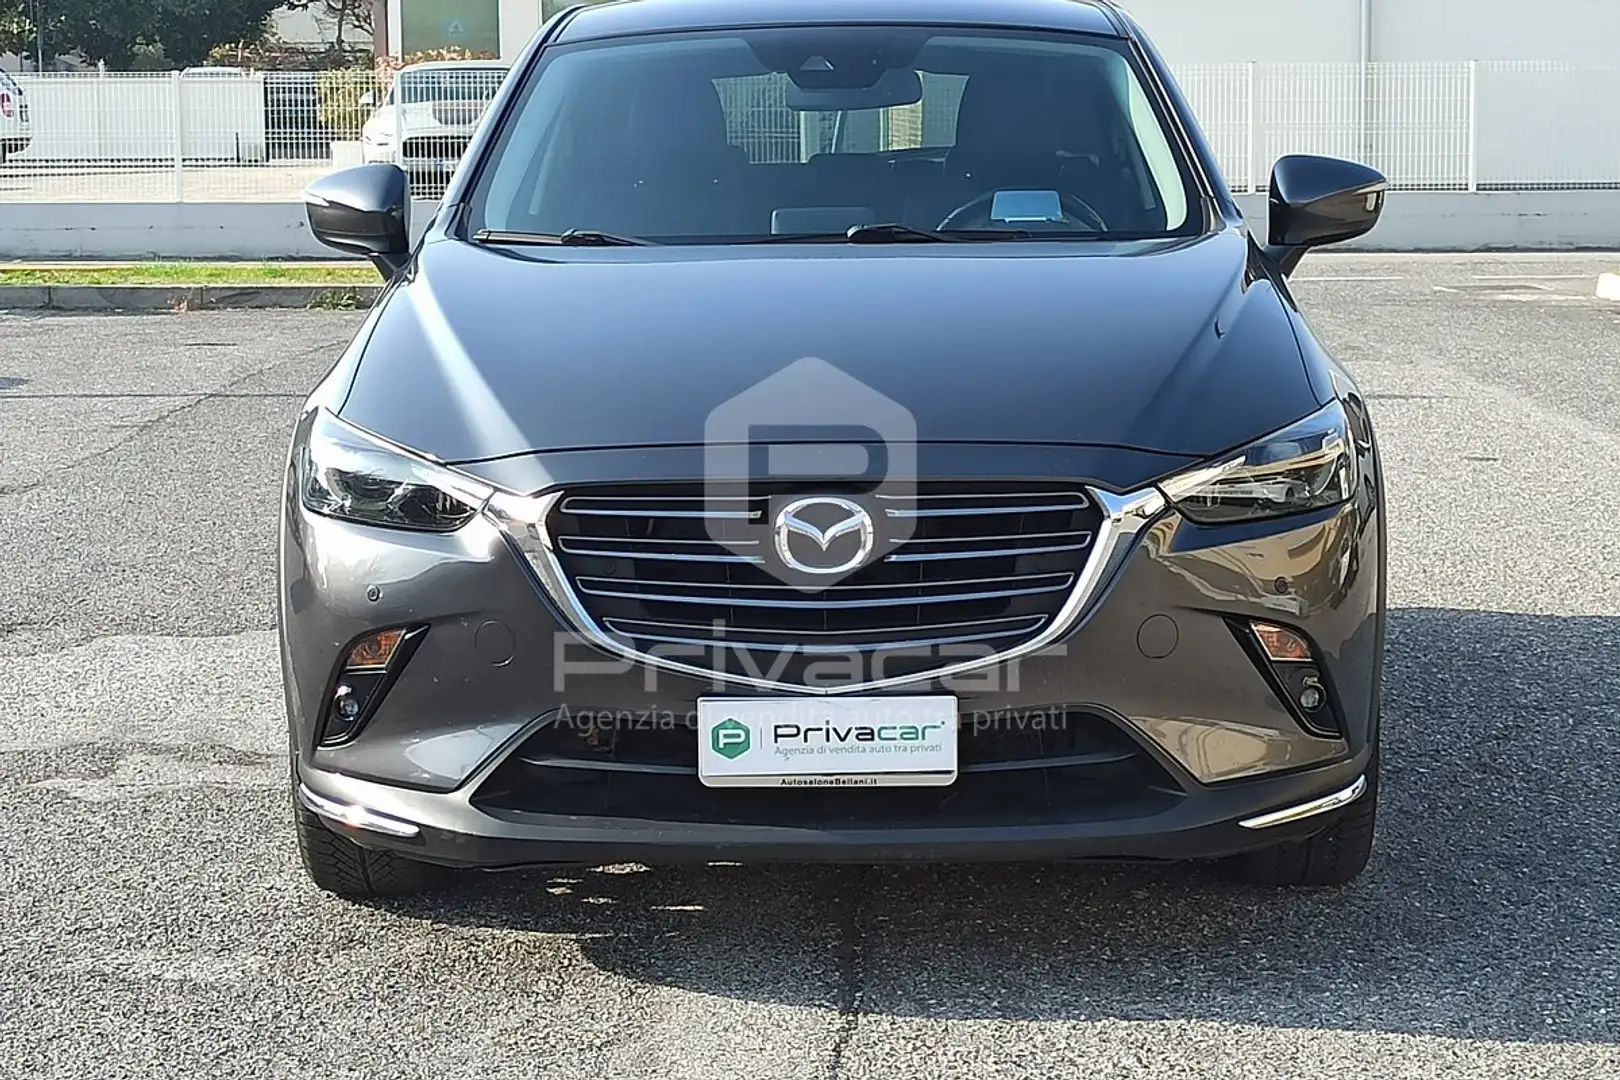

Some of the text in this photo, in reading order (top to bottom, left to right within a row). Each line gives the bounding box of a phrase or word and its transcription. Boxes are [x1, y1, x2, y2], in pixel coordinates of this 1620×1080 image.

[718, 728, 746, 750] P
[773, 720, 942, 744] Privacar
[774, 743, 942, 757] Agenzia di vendita auto tra privati
